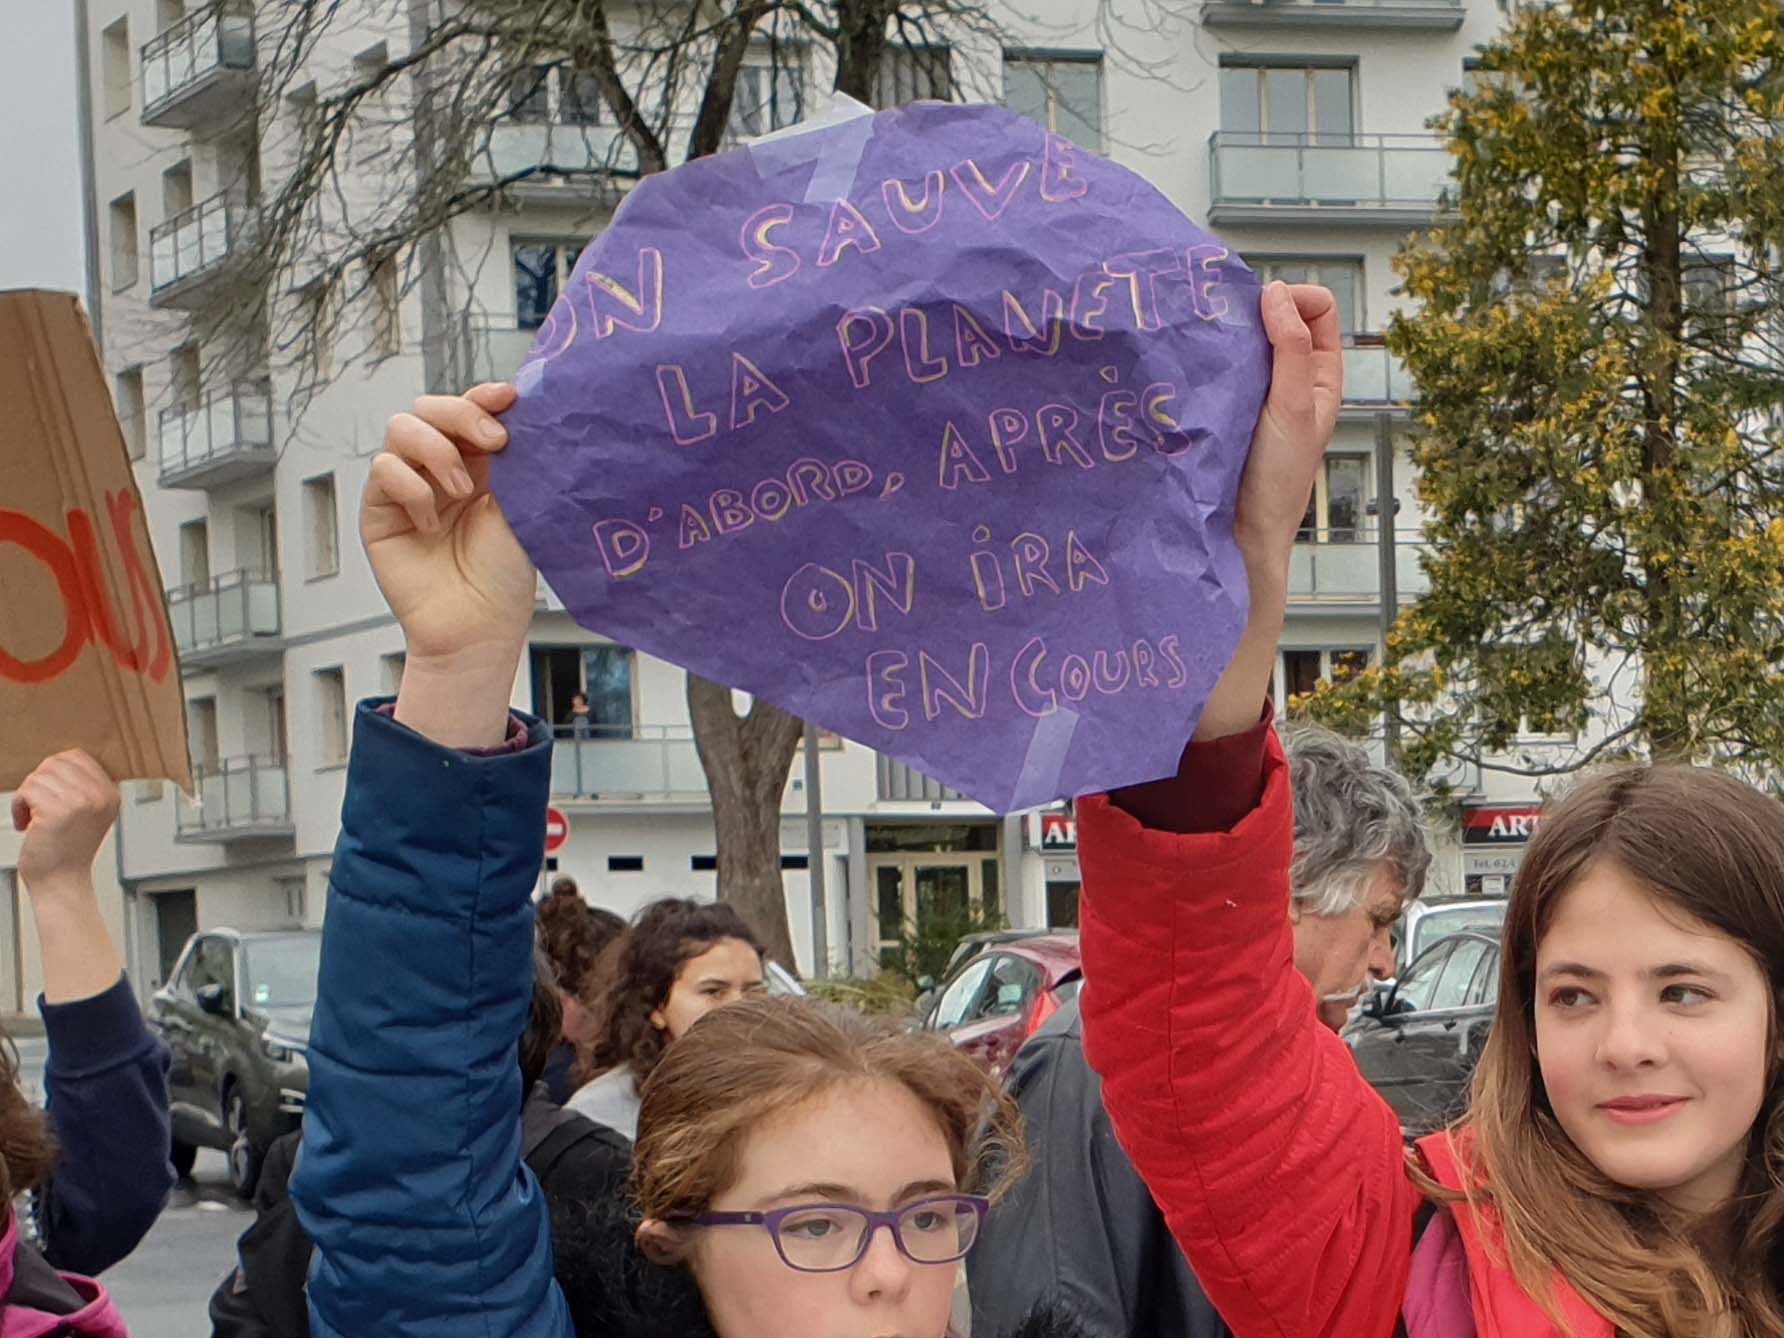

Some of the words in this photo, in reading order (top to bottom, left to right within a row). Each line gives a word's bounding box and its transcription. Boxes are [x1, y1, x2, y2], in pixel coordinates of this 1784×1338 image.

[739, 132, 1090, 290] SAUVE
[656, 350, 792, 447] LA
[938, 364, 1192, 490] APRÈS
[781, 550, 916, 641] ON
[866, 642, 990, 731] EN
[1010, 633, 1189, 718] COURS
